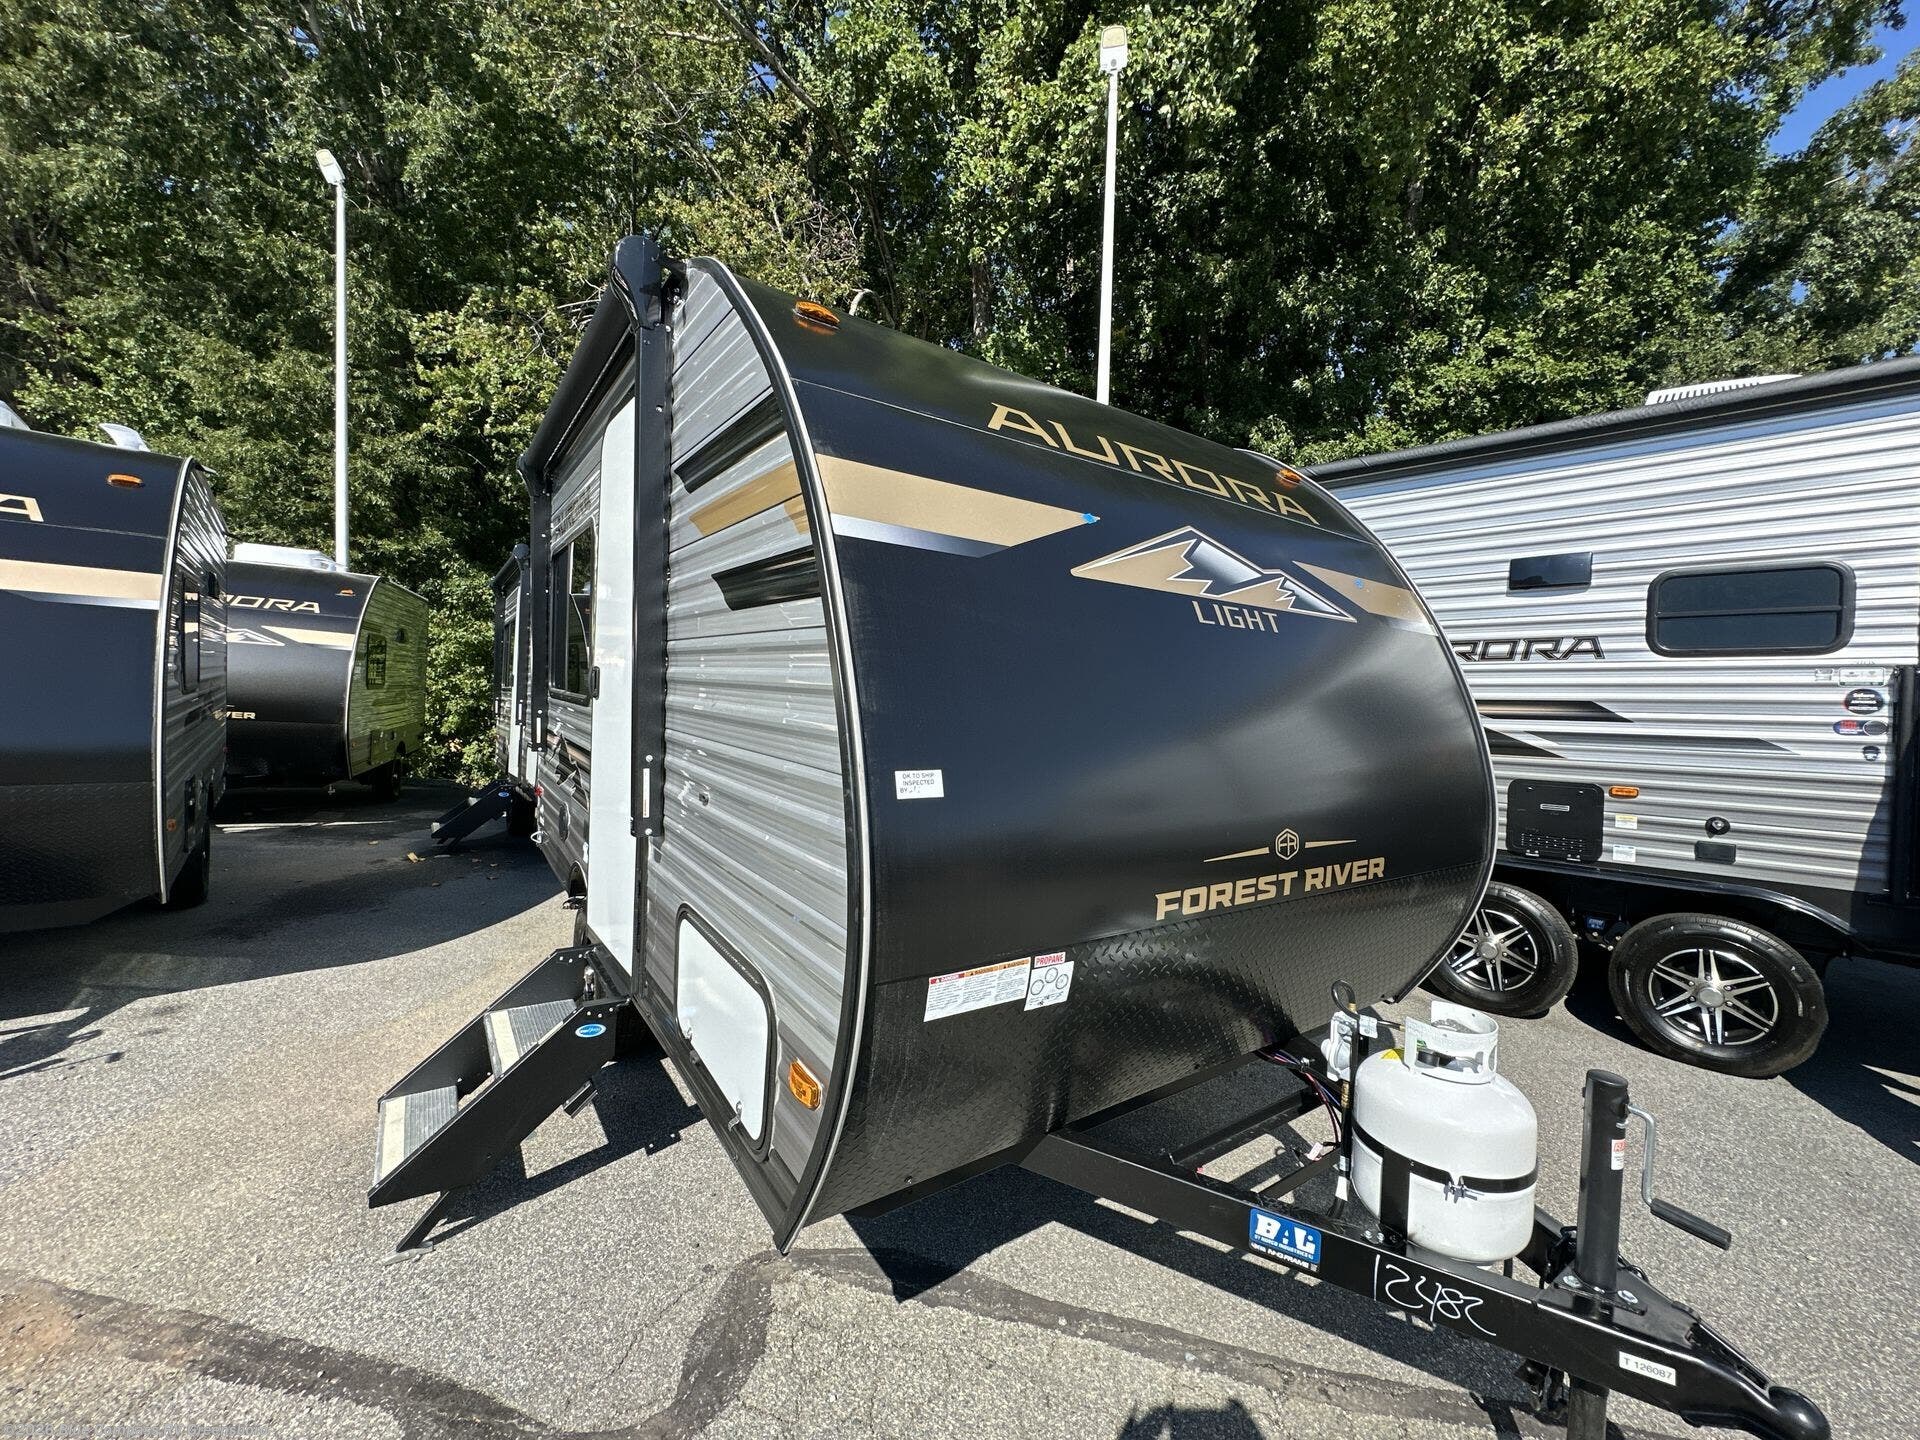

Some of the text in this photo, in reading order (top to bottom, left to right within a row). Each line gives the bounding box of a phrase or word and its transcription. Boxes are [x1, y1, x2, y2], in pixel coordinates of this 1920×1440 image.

[987, 402, 1319, 525] AURORA
[227, 595, 320, 613] ORA
[1192, 601, 1280, 634] LIGHT
[1155, 857, 1385, 921] FOREST RIVER
[1036, 954, 1064, 966] PROPANE
[1634, 1361, 1673, 1379] 126087
